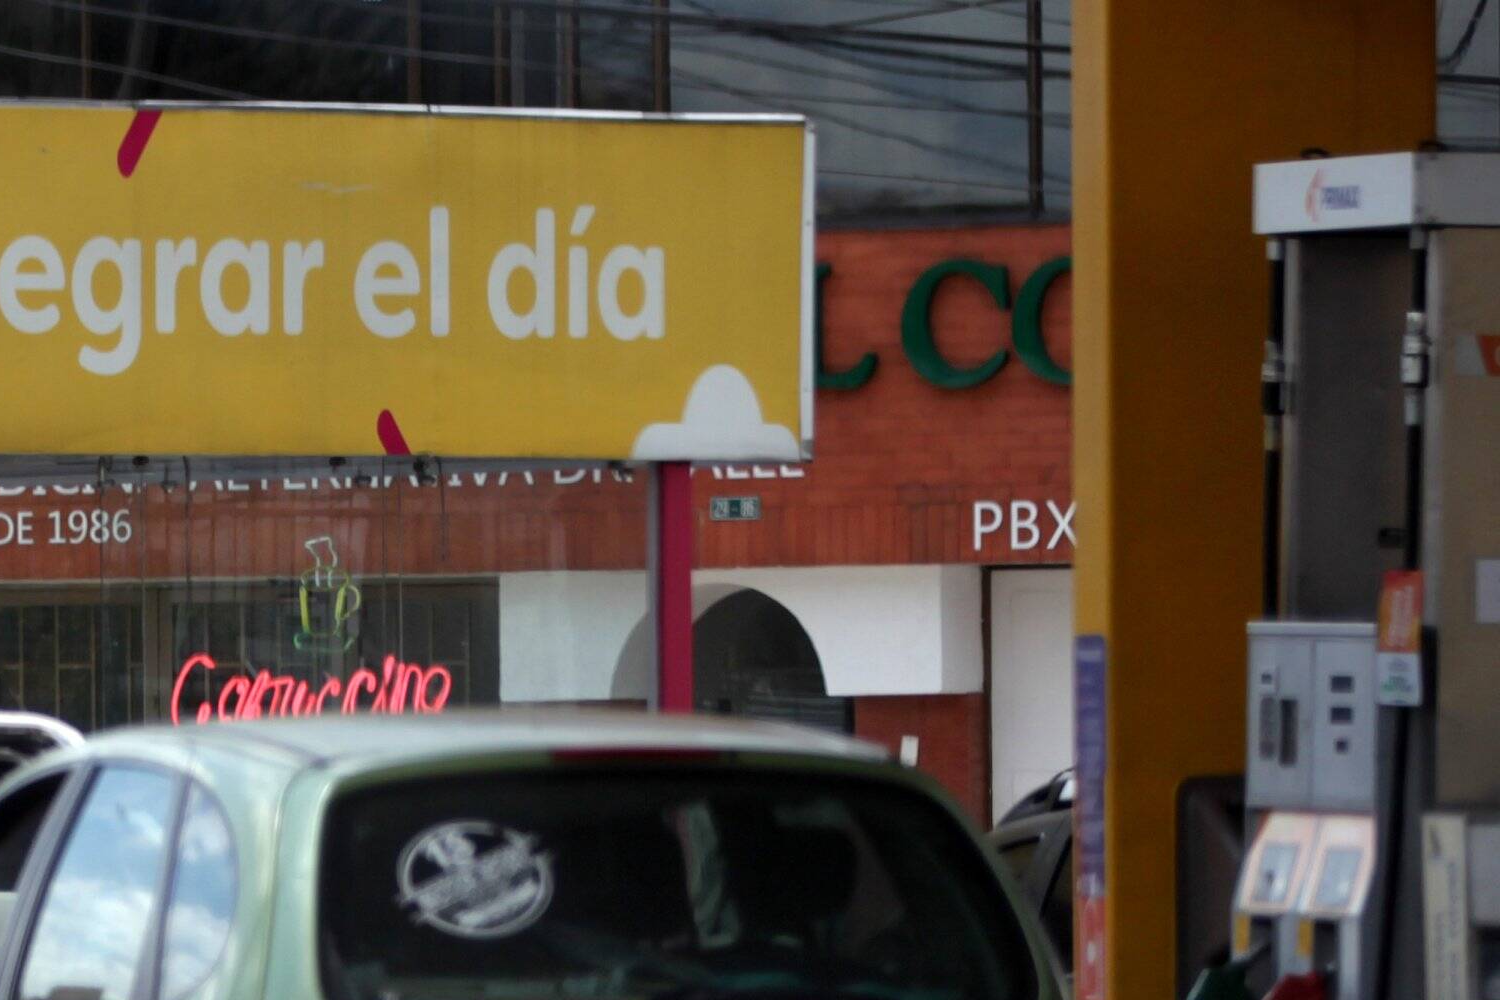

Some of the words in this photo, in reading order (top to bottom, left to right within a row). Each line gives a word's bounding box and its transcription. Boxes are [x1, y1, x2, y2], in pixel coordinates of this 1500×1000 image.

[354, 207, 450, 339] el
[488, 203, 664, 341] día
[48, 509, 132, 544] 1986
[974, 500, 1077, 550] PBX
